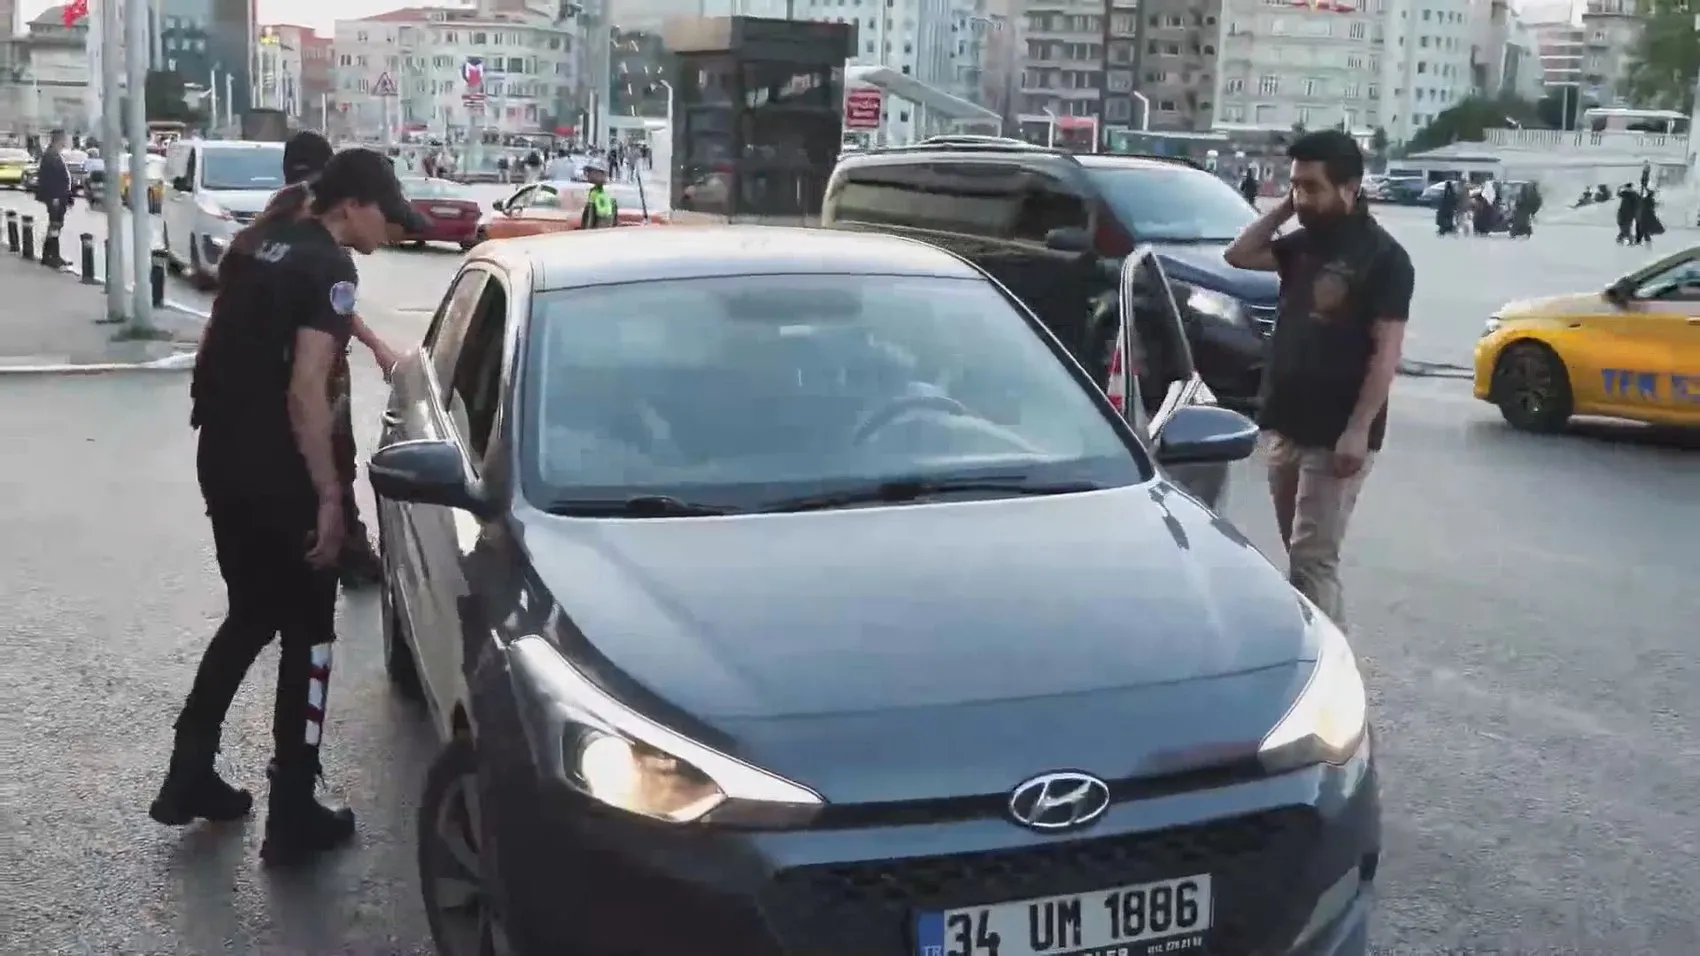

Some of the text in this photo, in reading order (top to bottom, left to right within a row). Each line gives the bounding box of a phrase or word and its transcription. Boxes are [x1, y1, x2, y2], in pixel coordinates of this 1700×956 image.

[947, 880, 1198, 956] 34 UM 1886
[923, 945, 942, 956] TR
